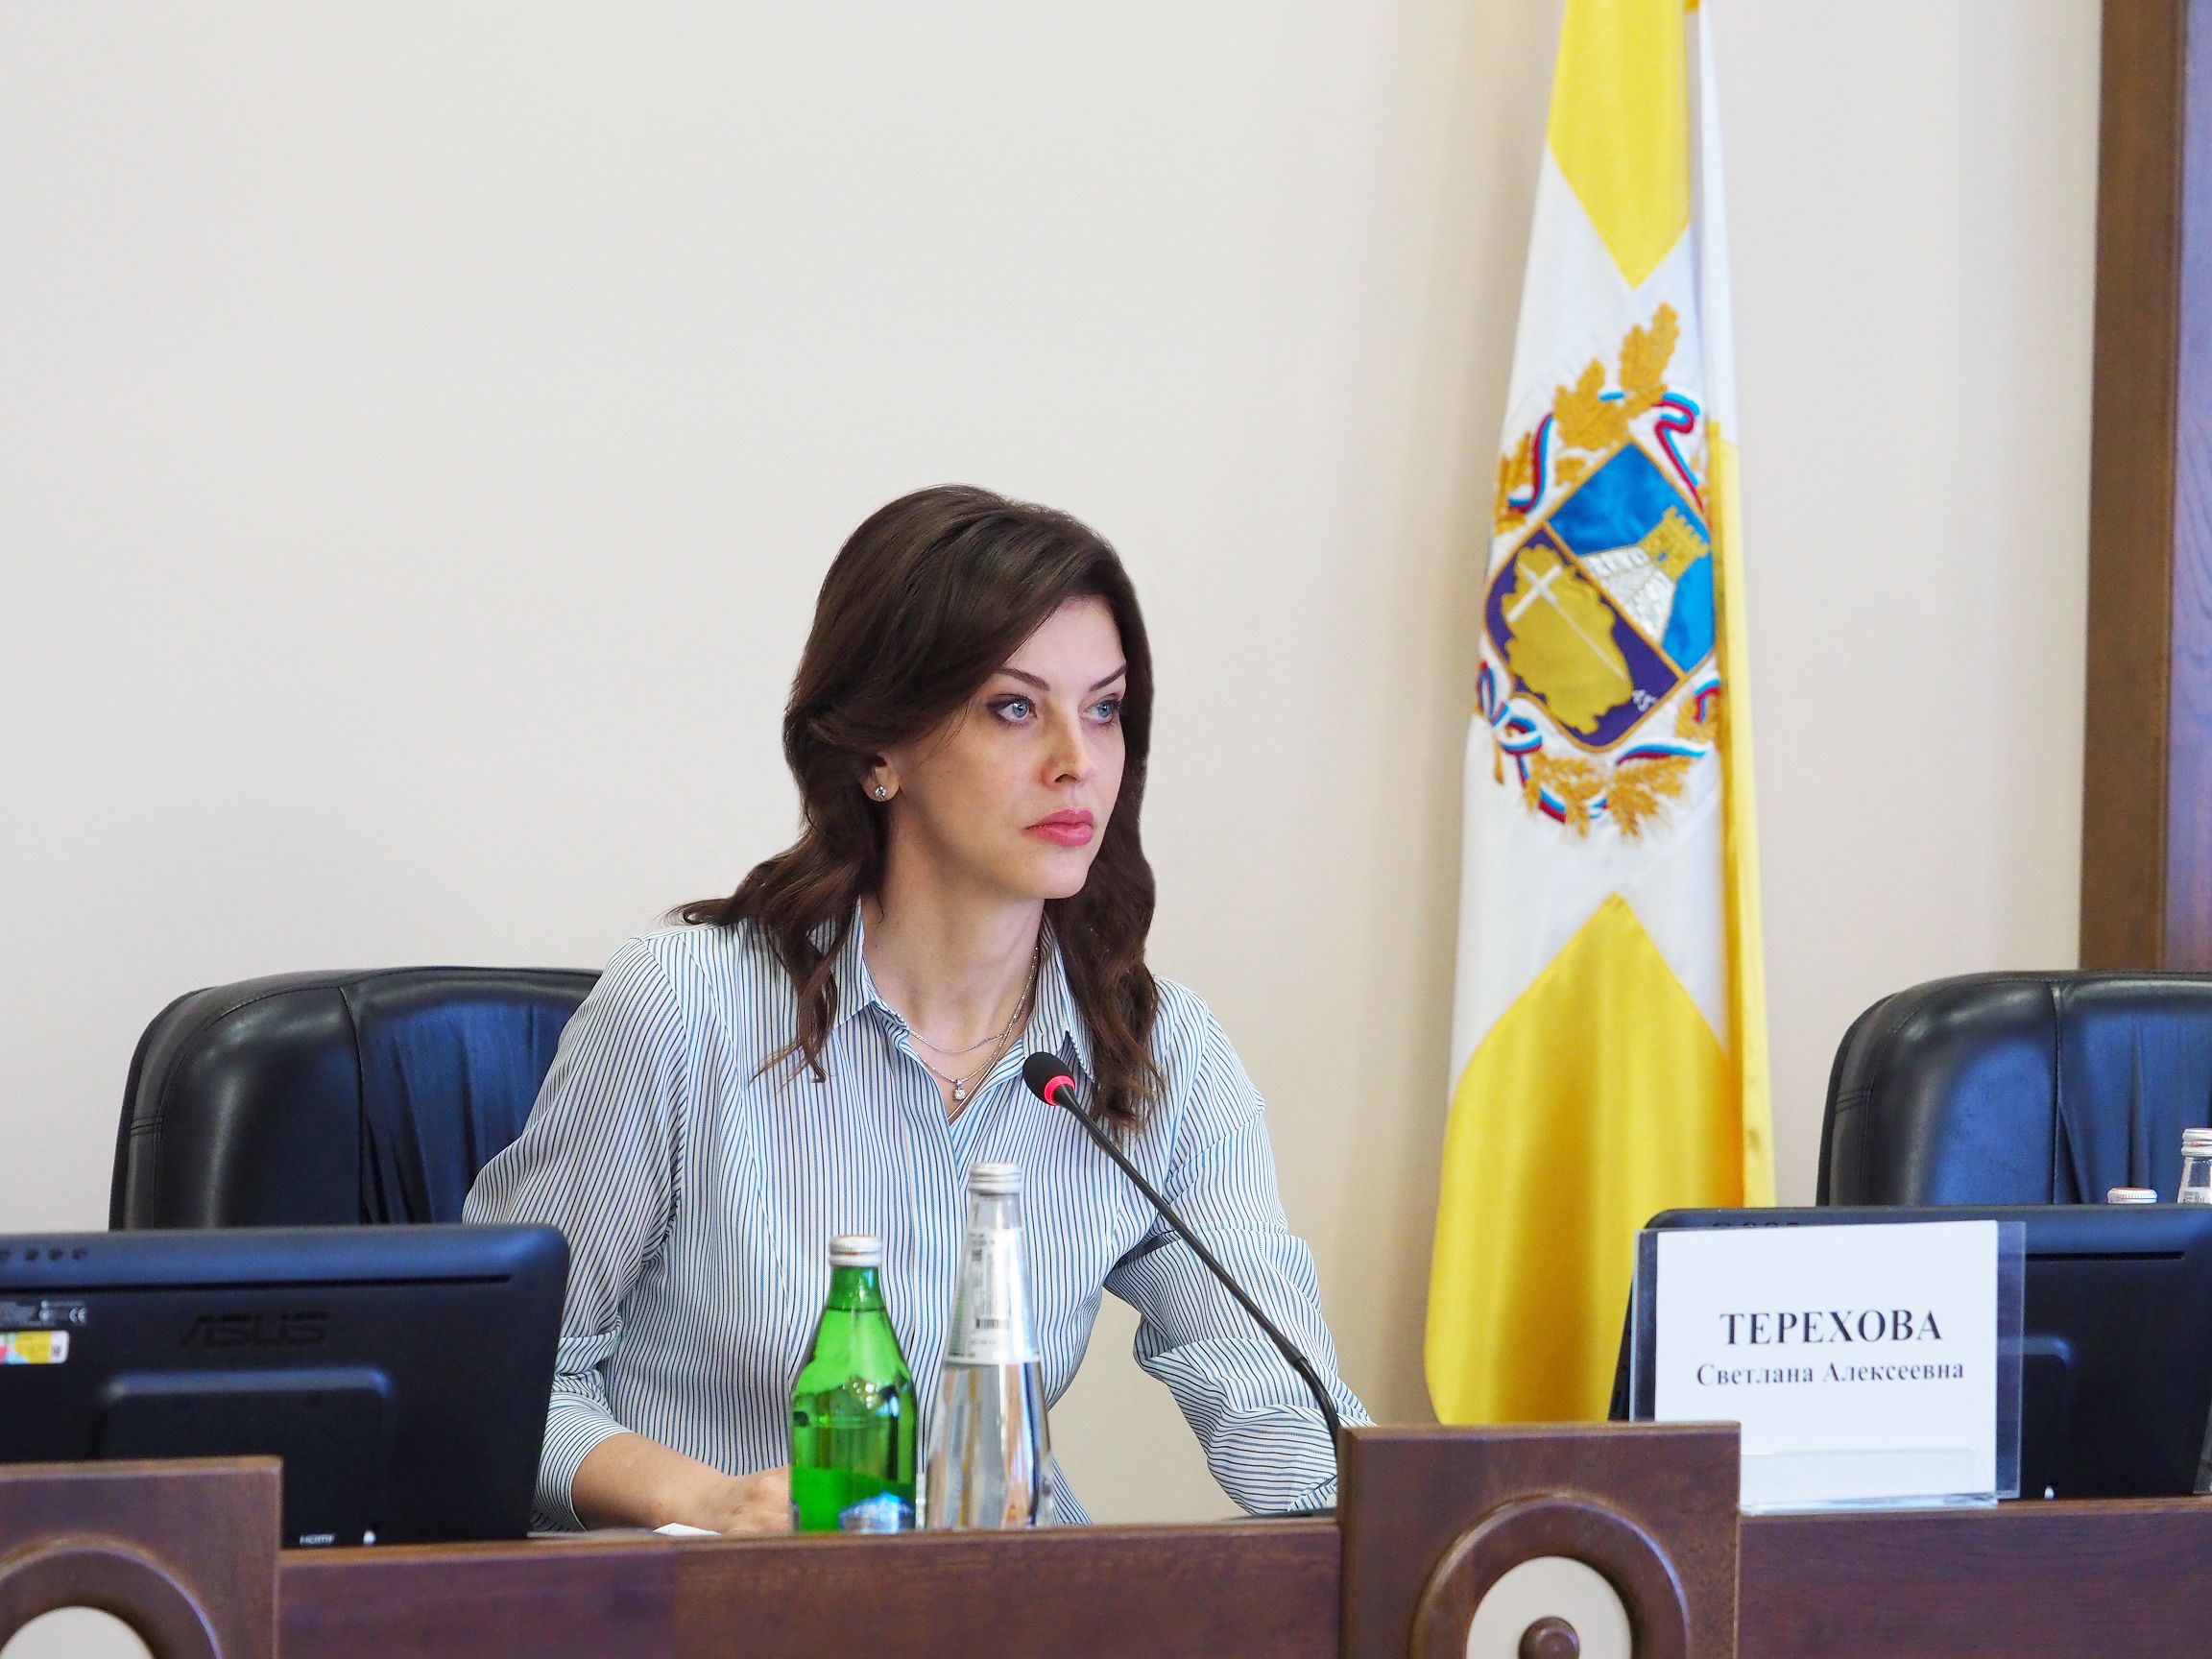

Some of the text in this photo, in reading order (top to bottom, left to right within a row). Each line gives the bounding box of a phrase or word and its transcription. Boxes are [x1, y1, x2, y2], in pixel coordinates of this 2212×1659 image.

[1719, 1308, 1943, 1346] ТЕРЕХОВА
[1695, 1360, 1964, 1386] Светлана Алексеевна
